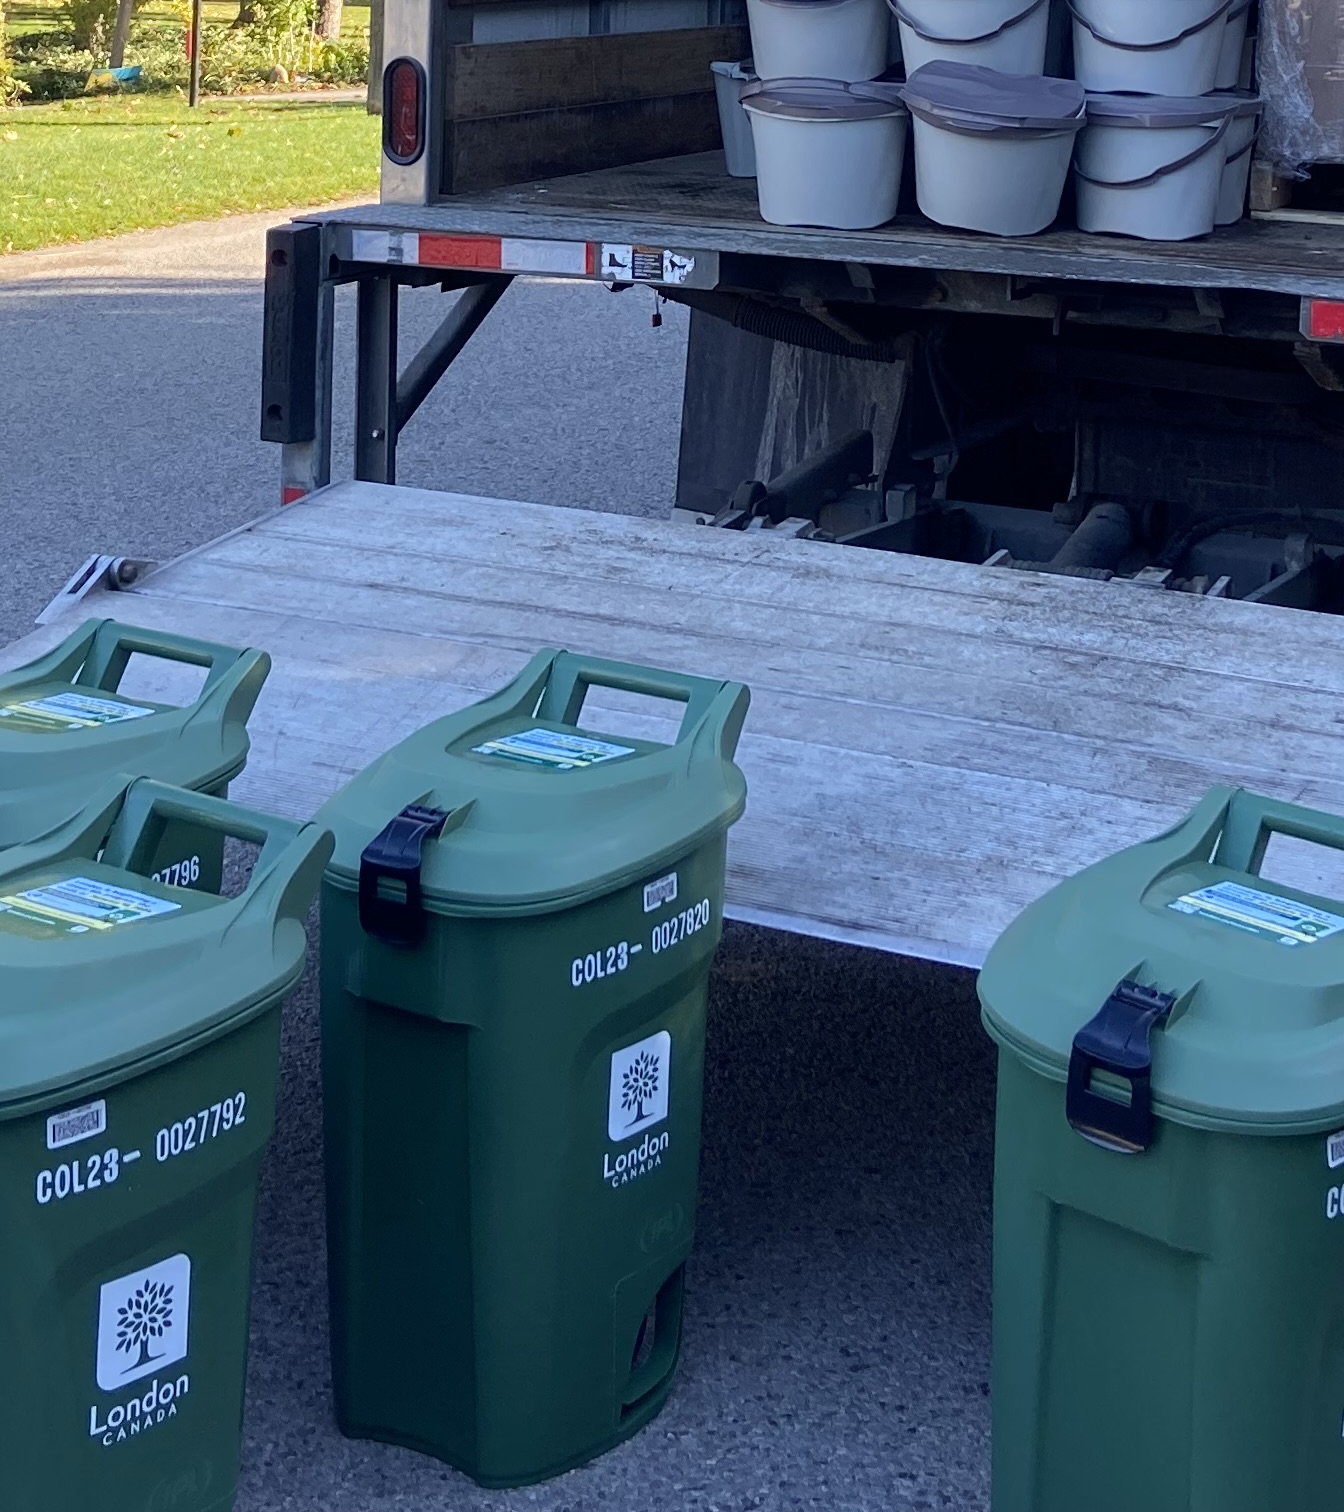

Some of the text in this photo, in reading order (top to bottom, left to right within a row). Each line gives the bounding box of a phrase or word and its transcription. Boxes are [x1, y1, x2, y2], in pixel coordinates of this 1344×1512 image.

[571, 897, 710, 987] COL23- 0027820
[36, 1091, 246, 1204] COL23- 0027792
[603, 1131, 669, 1179] London
[611, 1154, 662, 1188] CANADA
[89, 1374, 189, 1436] London
[102, 1402, 177, 1446] CANADA
